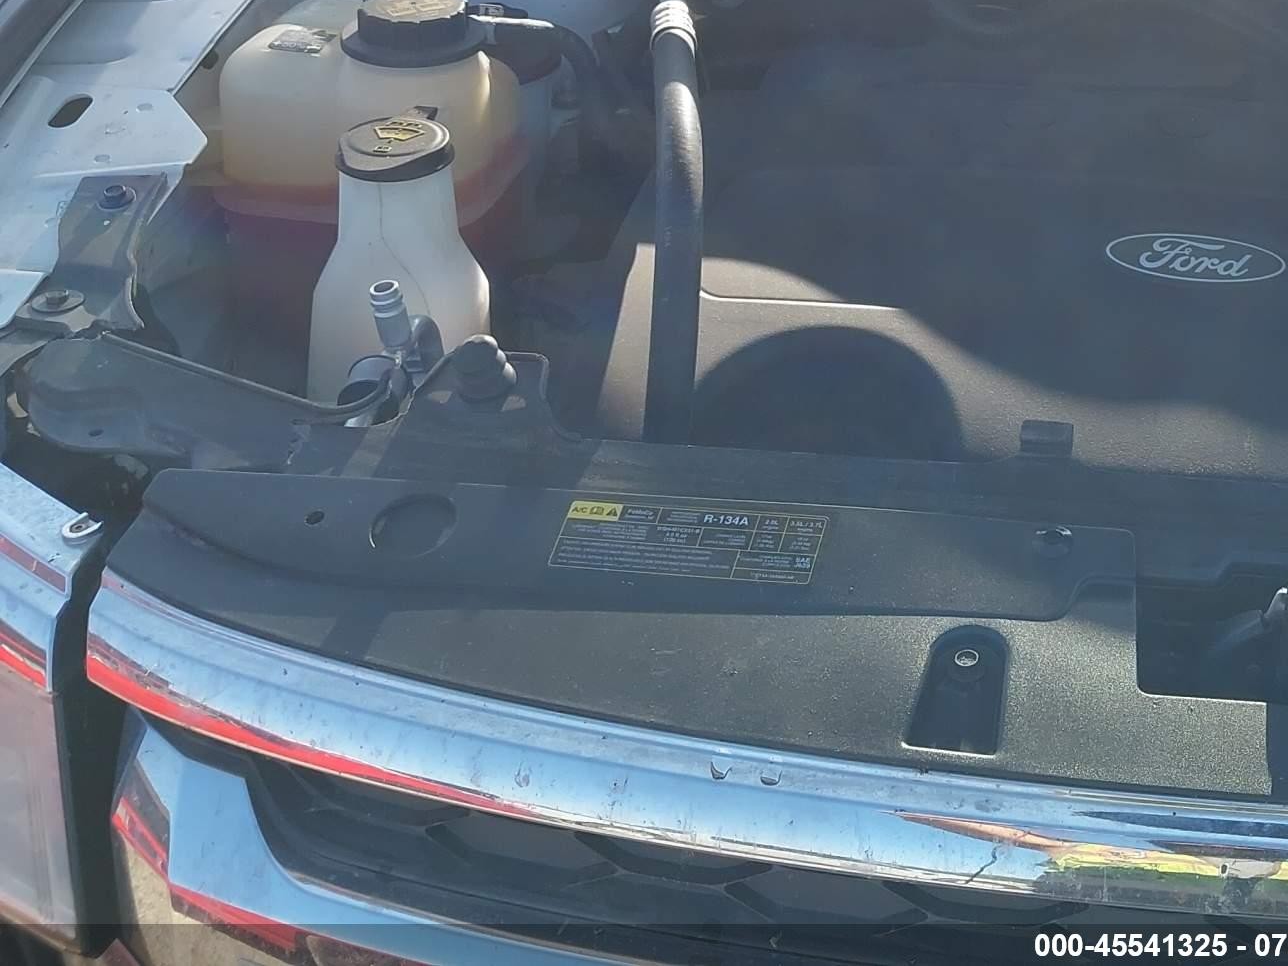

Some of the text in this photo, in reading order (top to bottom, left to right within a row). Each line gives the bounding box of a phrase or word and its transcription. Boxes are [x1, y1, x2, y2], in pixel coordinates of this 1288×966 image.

[1139, 238, 1252, 277] Ford
[571, 506, 588, 514] A/C
[703, 514, 749, 526] R-134A
